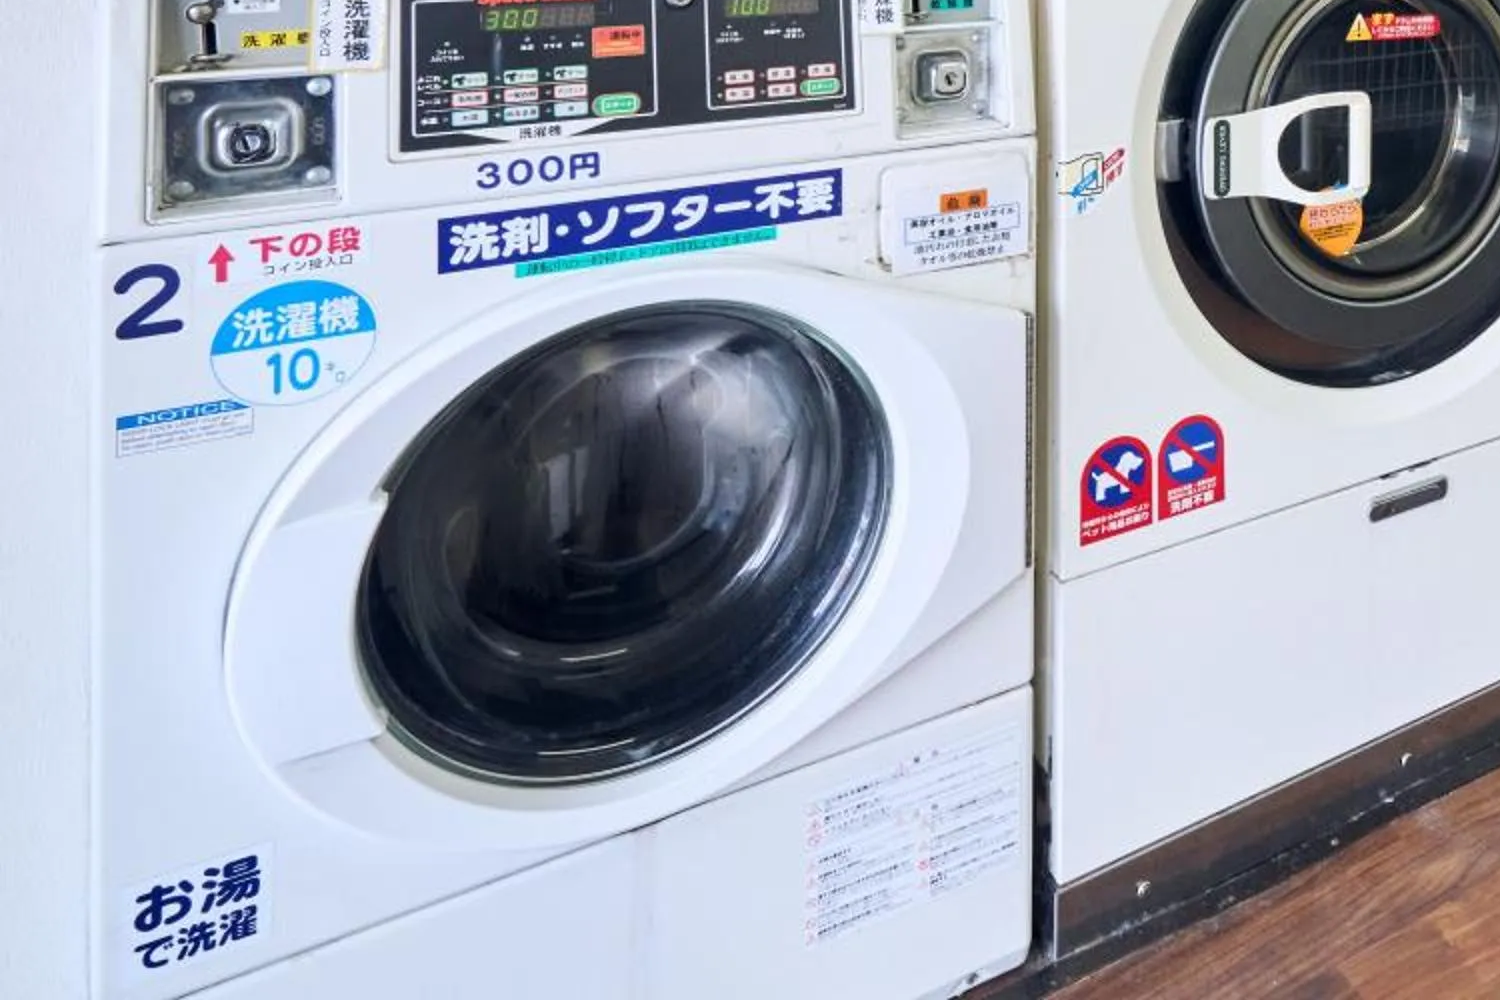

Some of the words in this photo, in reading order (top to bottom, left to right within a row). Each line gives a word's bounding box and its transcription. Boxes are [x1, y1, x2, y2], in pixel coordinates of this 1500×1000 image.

[485, 8, 538, 31] 300
[477, 152, 600, 189] 300円
[248, 226, 361, 263] 下の段
[449, 176, 836, 266] 洗剤・ソフター不要
[264, 254, 353, 275] コイン投入口
[113, 263, 184, 341] 2
[231, 295, 360, 348] 洗濯機
[266, 347, 320, 395] 10
[136, 400, 237, 426] NOTICE
[134, 854, 261, 932] お湯
[134, 904, 257, 969] で洗濯
